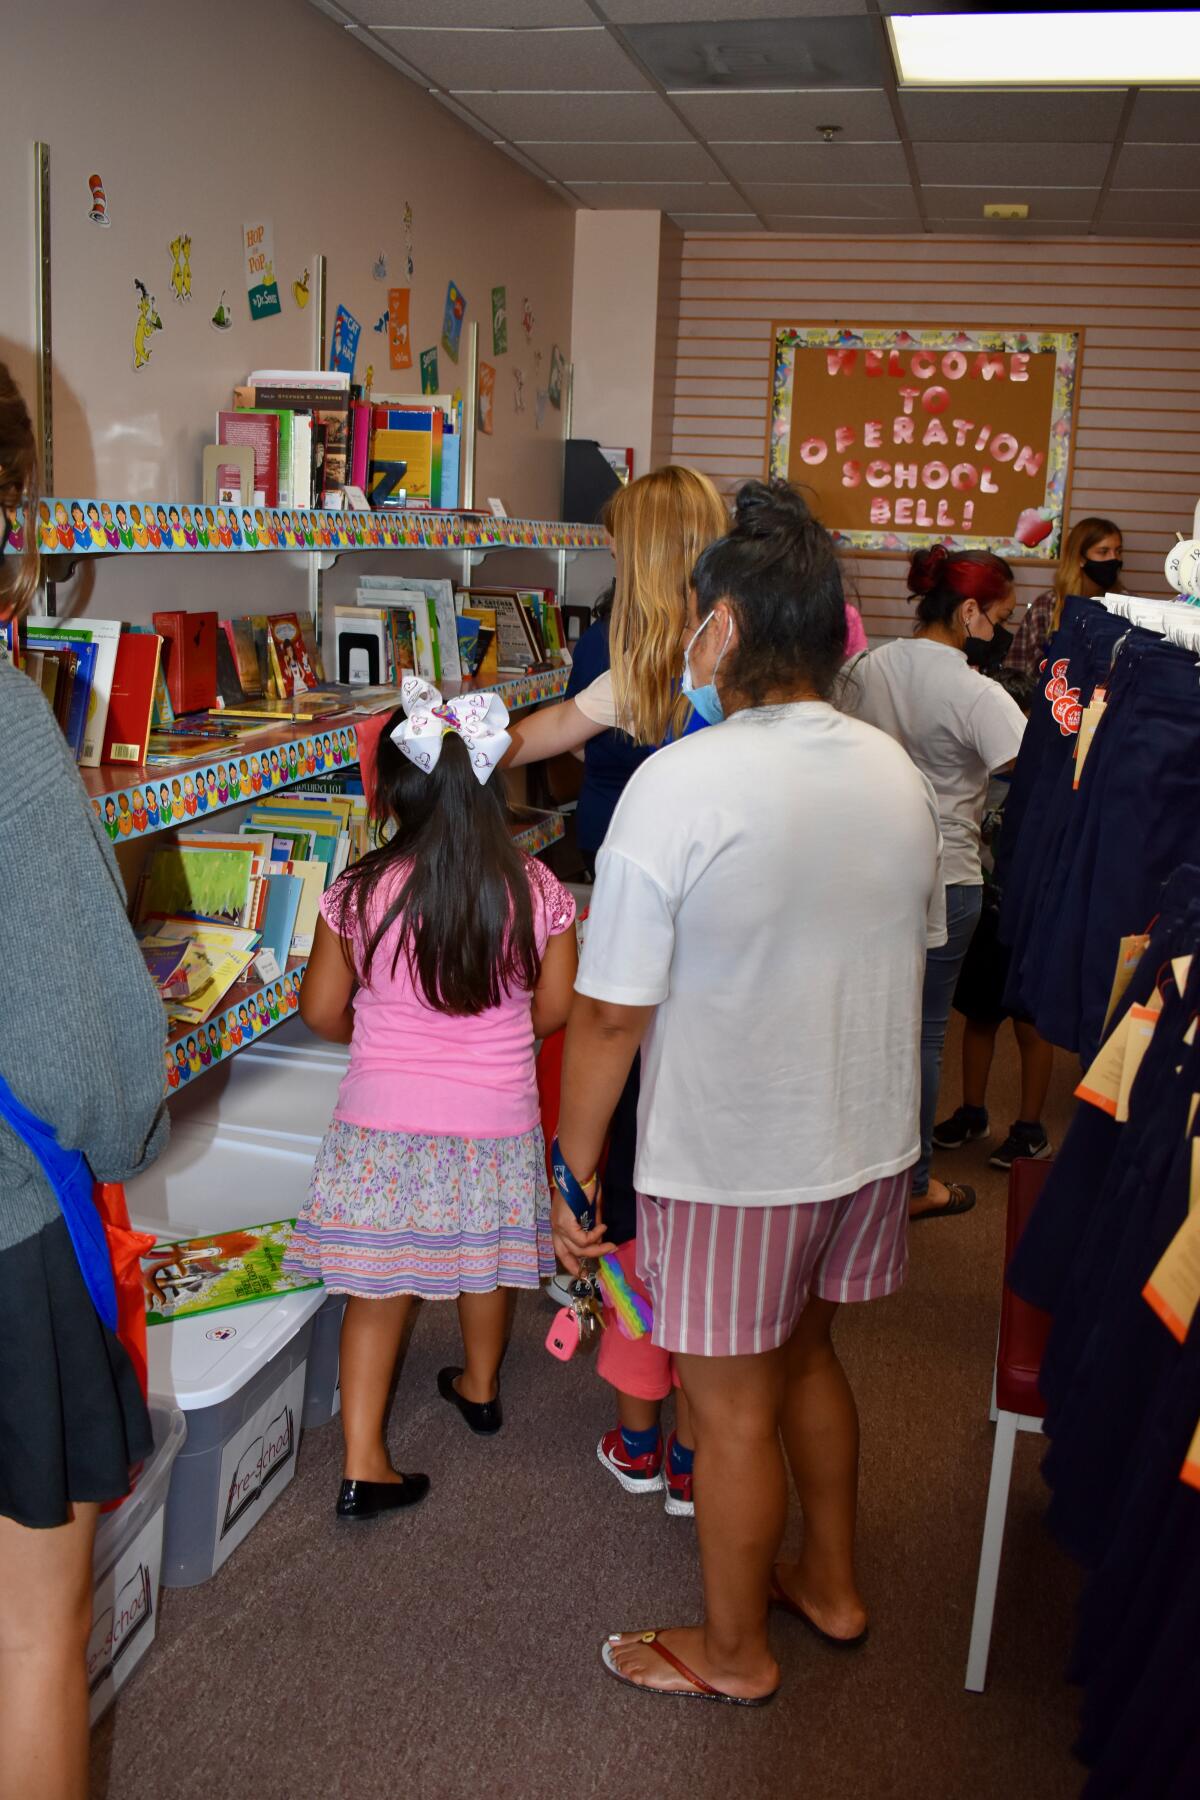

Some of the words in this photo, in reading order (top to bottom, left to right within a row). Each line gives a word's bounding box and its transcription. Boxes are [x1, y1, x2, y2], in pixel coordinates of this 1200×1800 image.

[247, 226, 264, 248] HOP
[248, 253, 265, 274] POP
[826, 349, 1030, 382] WELCOME
[898, 386, 951, 415] TO
[800, 416, 1044, 477] OPERATION
[841, 460, 999, 494] SCHOOL
[870, 497, 975, 530] BELL!
[1169, 558, 1180, 571] 20
[329, 784, 341, 795] 101
